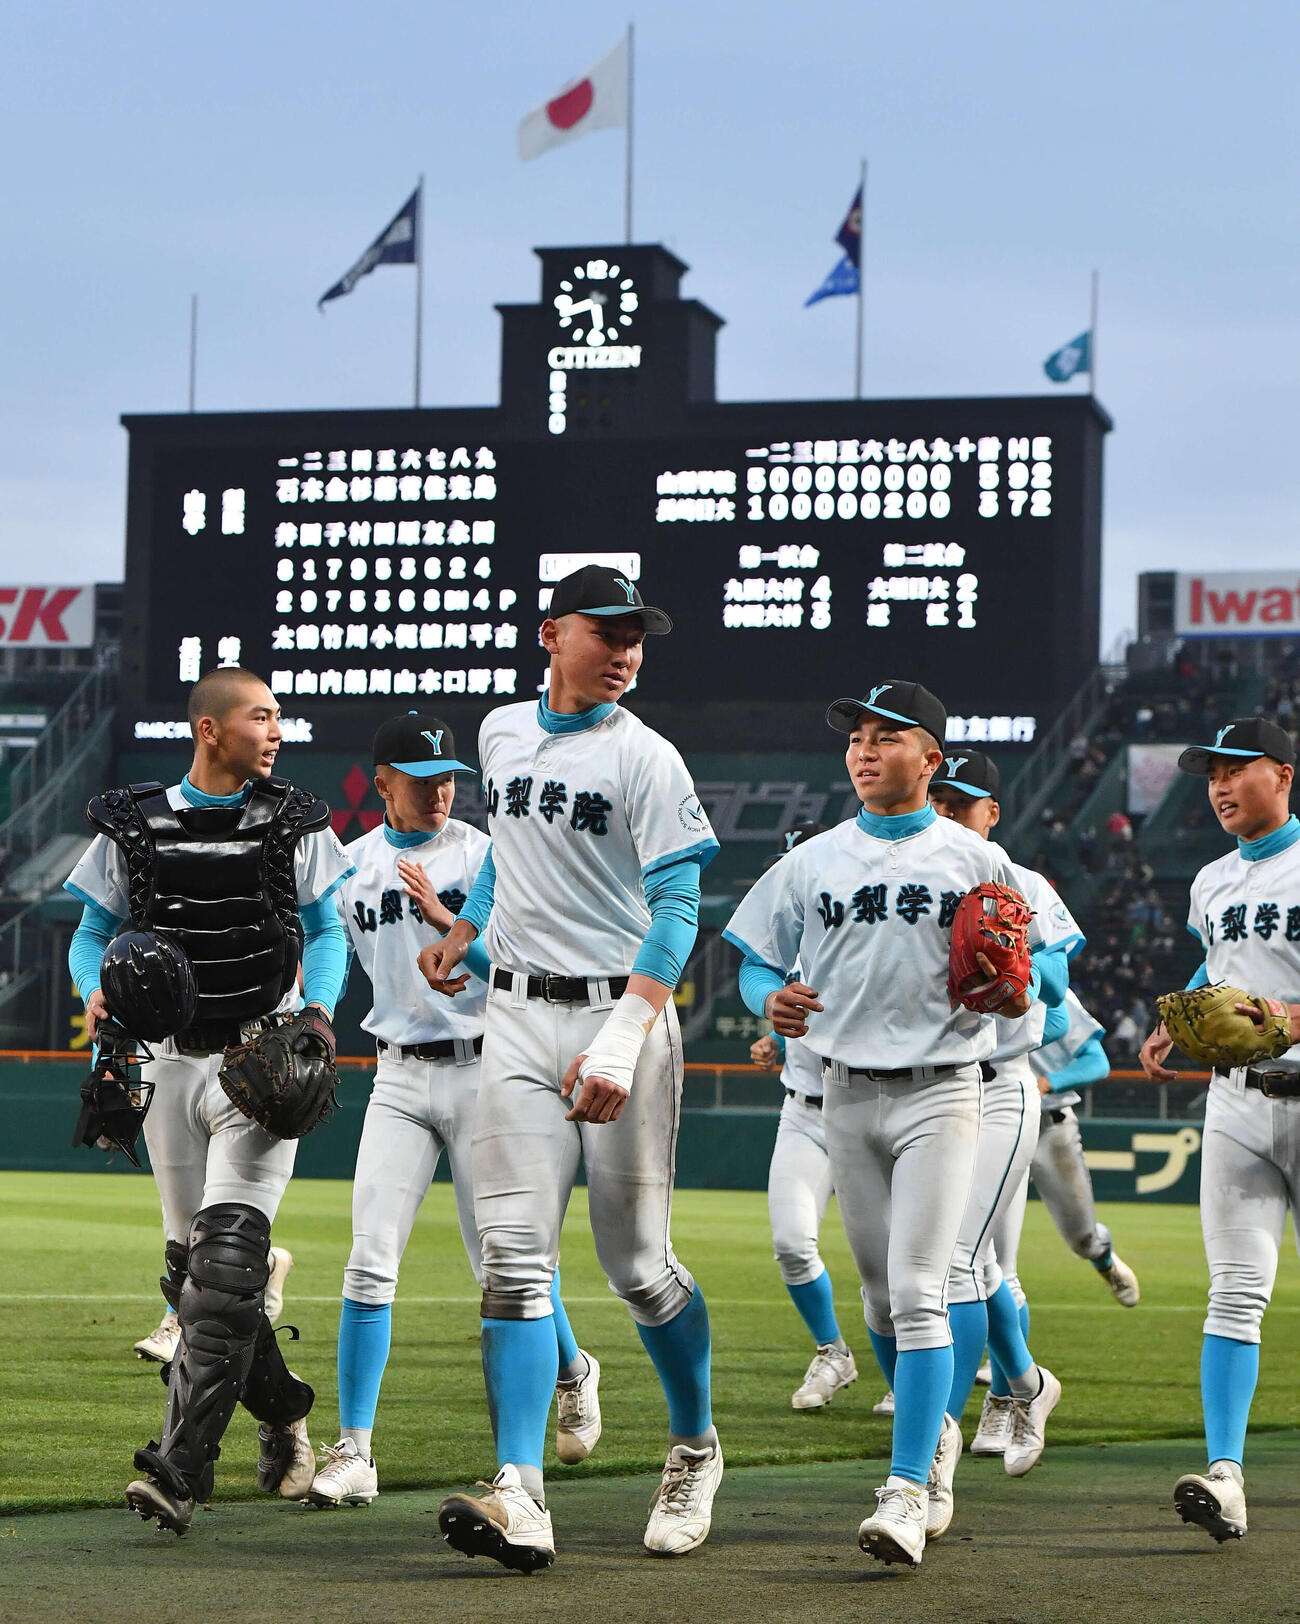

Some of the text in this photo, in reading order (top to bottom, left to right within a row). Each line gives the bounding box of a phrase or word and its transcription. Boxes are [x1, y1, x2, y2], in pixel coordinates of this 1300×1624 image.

[548, 343, 642, 369] CITIZEN
[613, 578, 635, 605] Y
[866, 684, 893, 705] Y
[420, 729, 444, 756] Y
[1214, 724, 1236, 748] Y
[944, 757, 968, 778] Y
[484, 776, 613, 837] 山梨学院
[784, 831, 803, 851] Y
